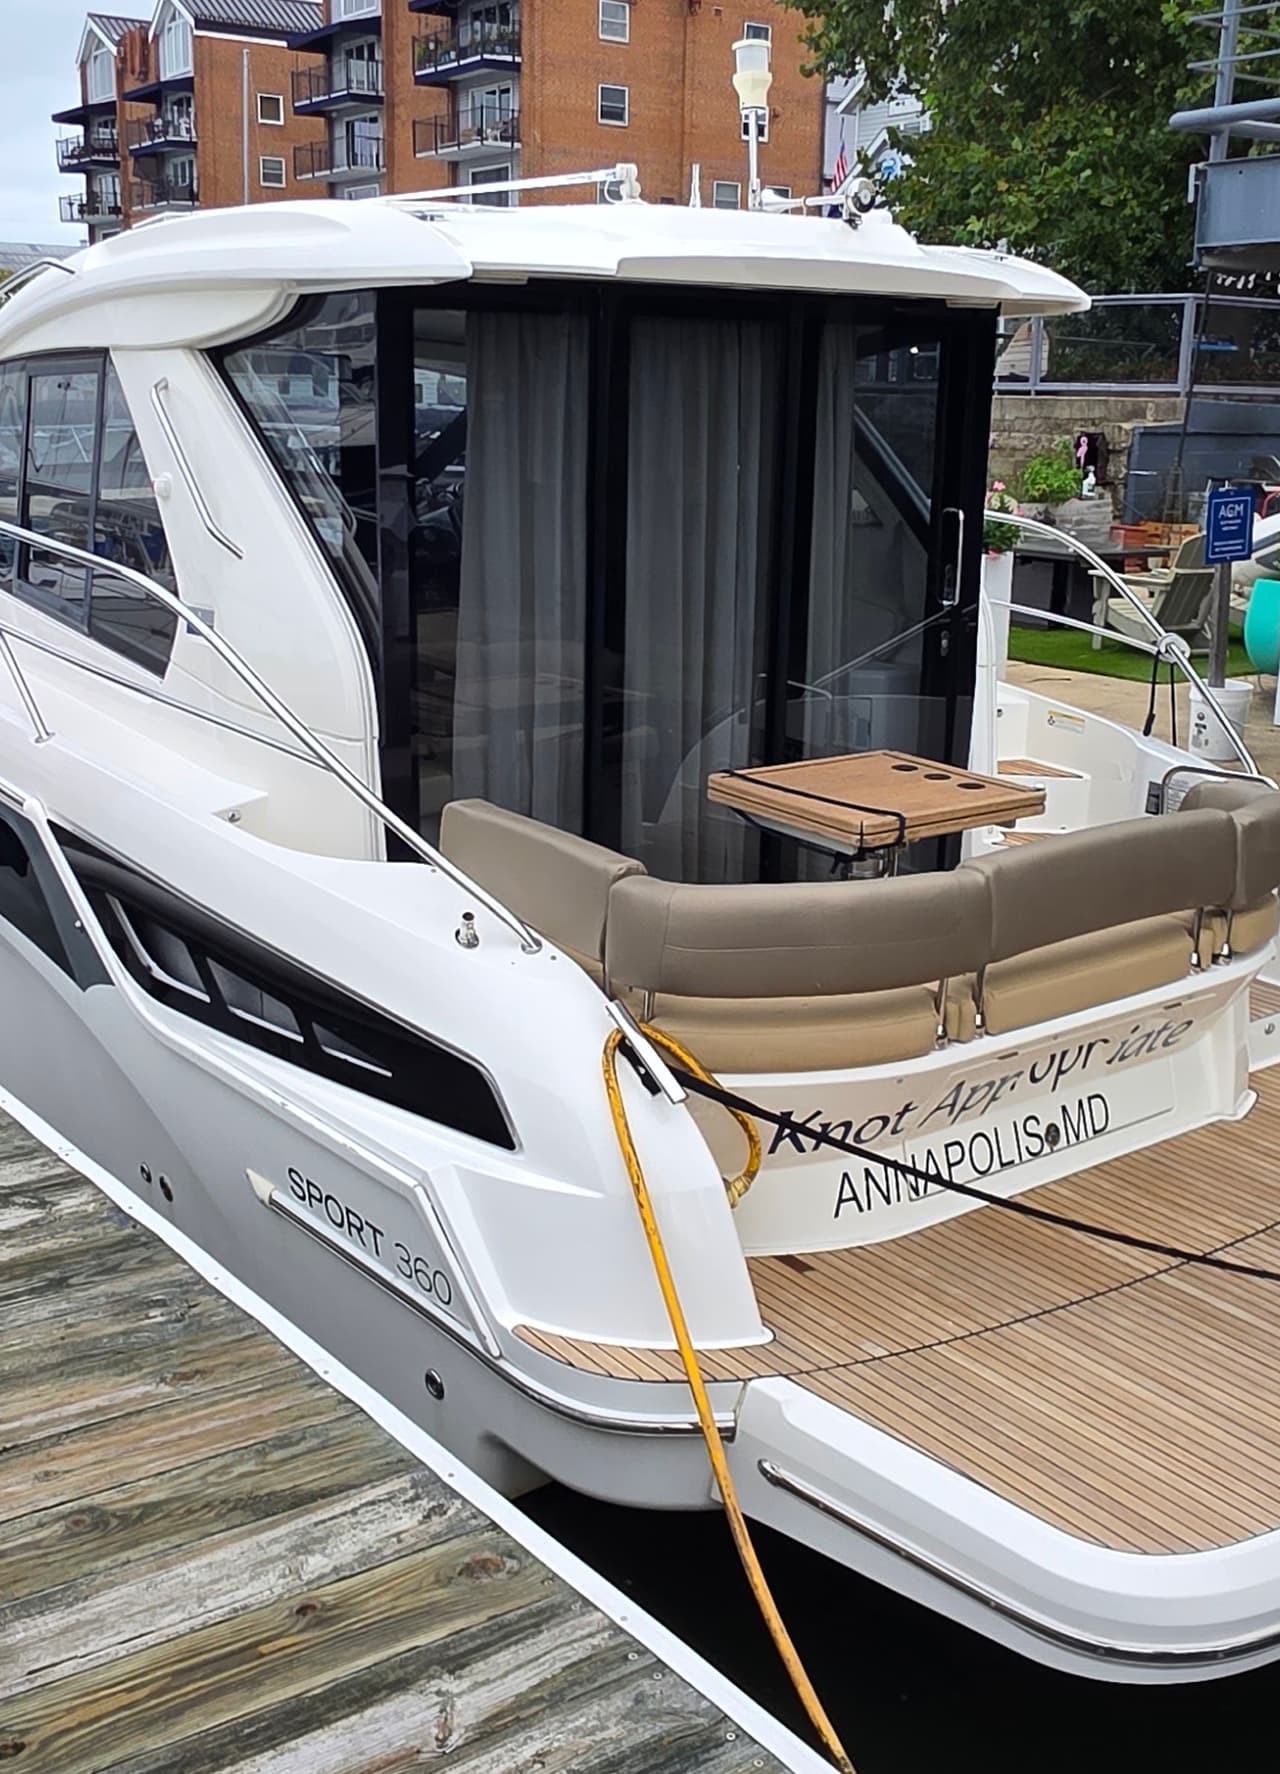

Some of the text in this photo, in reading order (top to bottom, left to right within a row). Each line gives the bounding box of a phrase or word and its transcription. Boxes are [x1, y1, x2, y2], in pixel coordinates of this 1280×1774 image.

[767, 1100, 919, 1155] Knot
[833, 1093, 1110, 1219] ANNAPOLIS MD
[287, 1167, 452, 1306] SPORT 360
